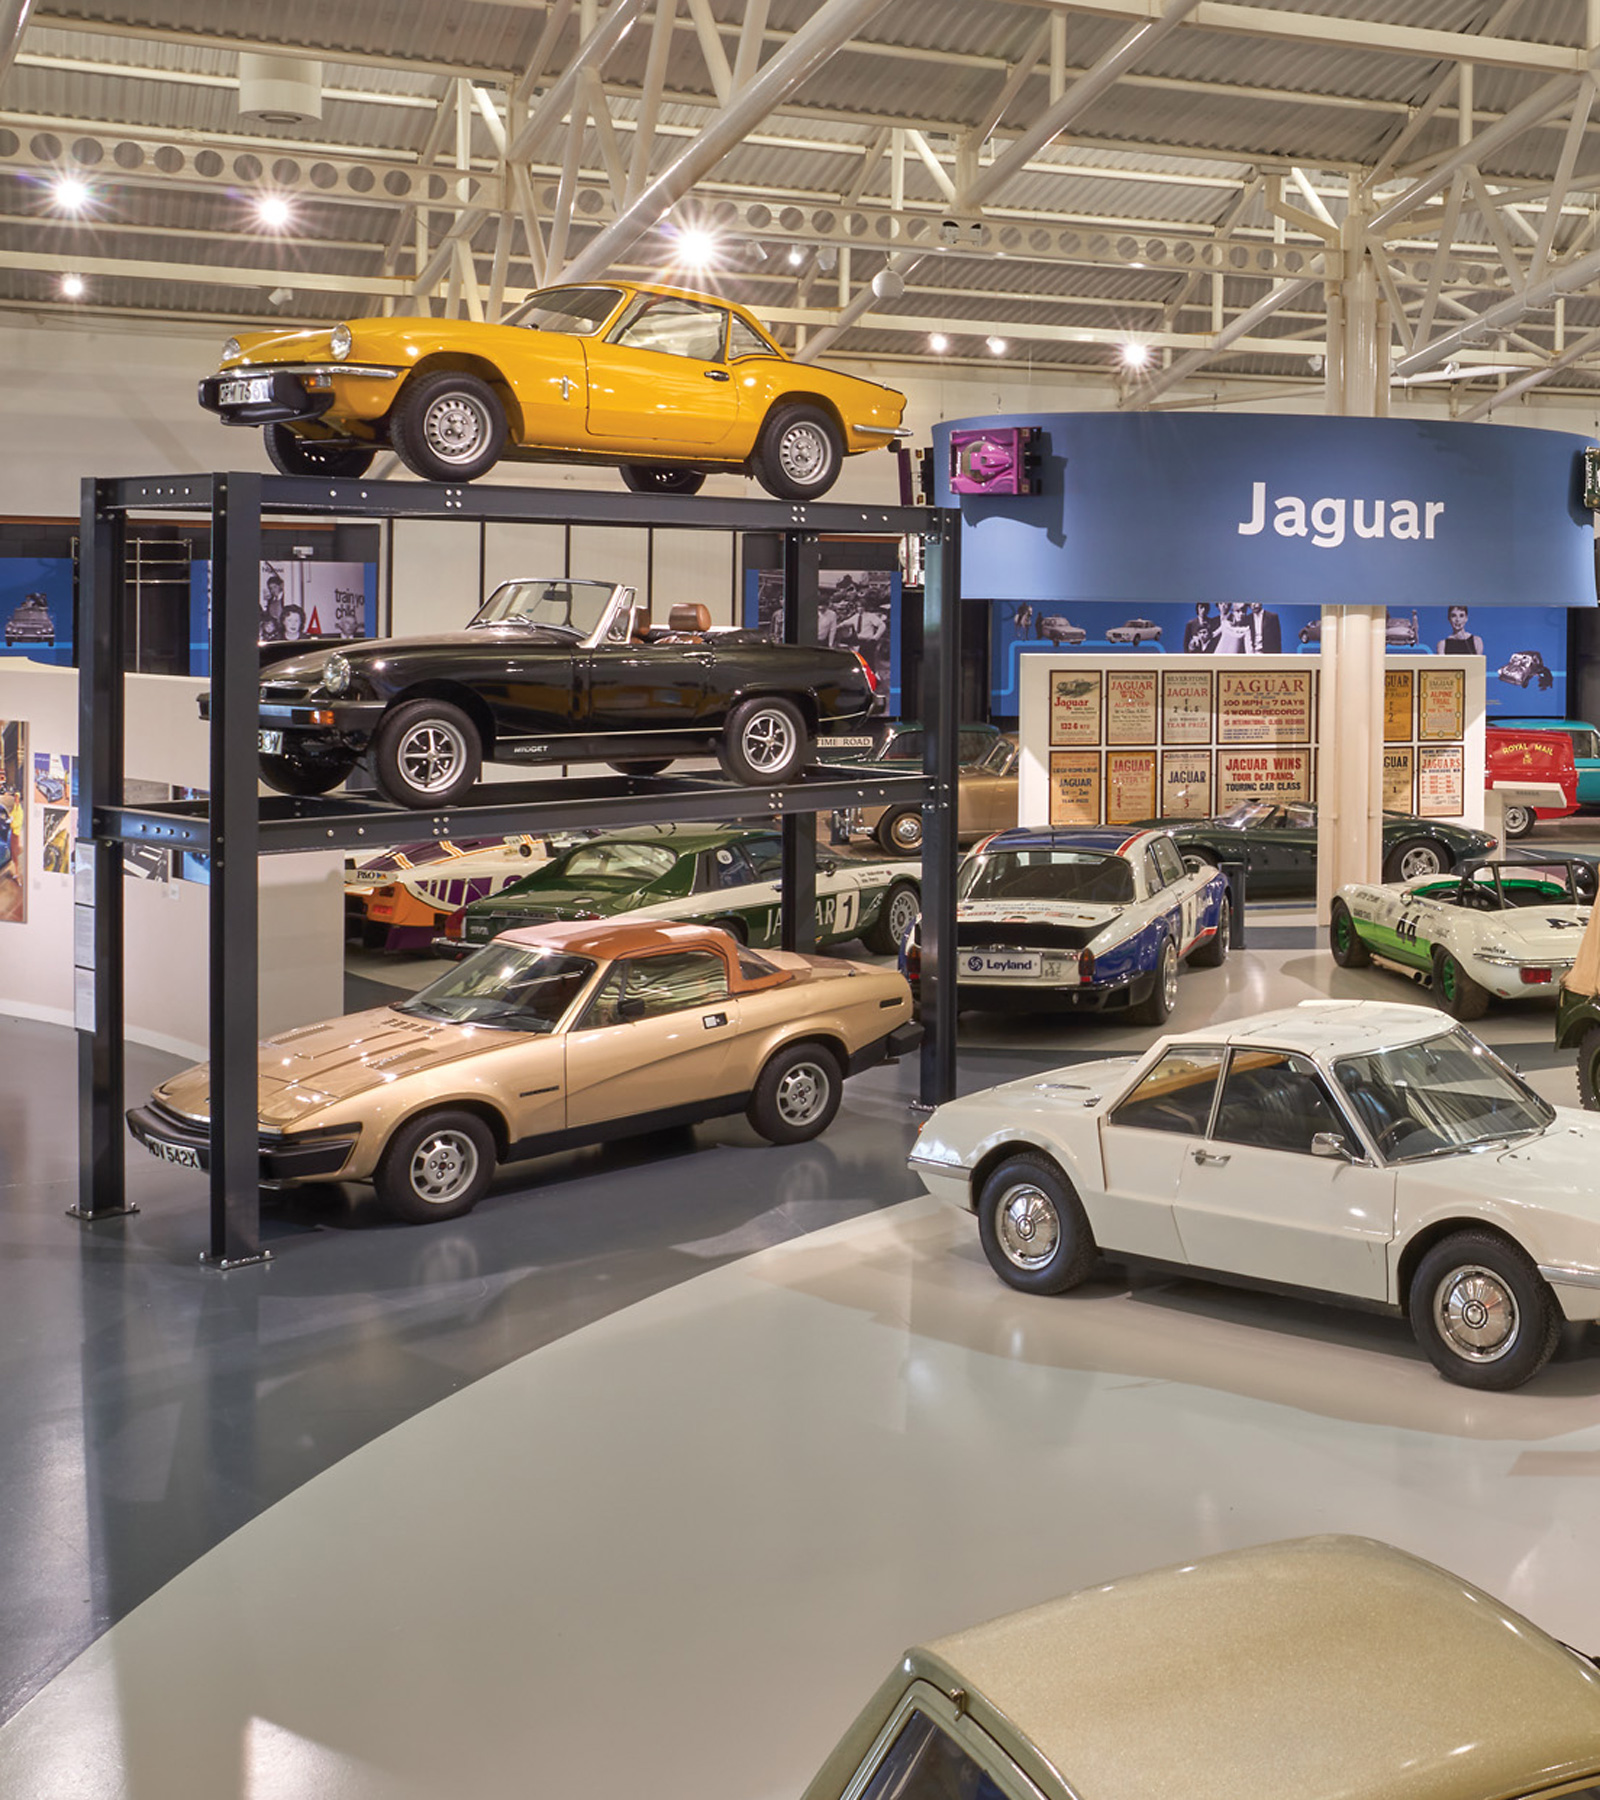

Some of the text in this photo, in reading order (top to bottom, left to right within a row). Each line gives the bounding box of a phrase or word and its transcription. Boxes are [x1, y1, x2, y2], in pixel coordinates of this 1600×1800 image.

[1238, 482, 1444, 548] Jaguar
[1111, 681, 1153, 690] JAGUAR
[1224, 679, 1305, 692] JAGUAR
[1385, 675, 1409, 687] GUAR
[1167, 688, 1208, 697] JAGUAR
[1054, 697, 1089, 710] Jaguar
[1262, 708, 1305, 716] RECORDS
[514, 745, 548, 753] MIDGET
[1502, 743, 1554, 756] ROYAL MAIL
[1113, 760, 1151, 772] JAGUAR
[1226, 758, 1301, 770] JAGUAR WINS
[1383, 756, 1408, 768] GUAR
[1422, 758, 1461, 768] JAGUARS
[1059, 778, 1092, 787] JAGUAR
[1168, 771, 1206, 783] JAGUAR
[1232, 773, 1252, 781] TOUR
[1265, 772, 1294, 781] FRANCE
[1226, 782, 1301, 791] TOURING CAR CLASS
[843, 894, 853, 929] 1
[1396, 912, 1421, 947] 44
[987, 959, 1032, 971] Leyland
[165, 1146, 199, 1169] 542X
